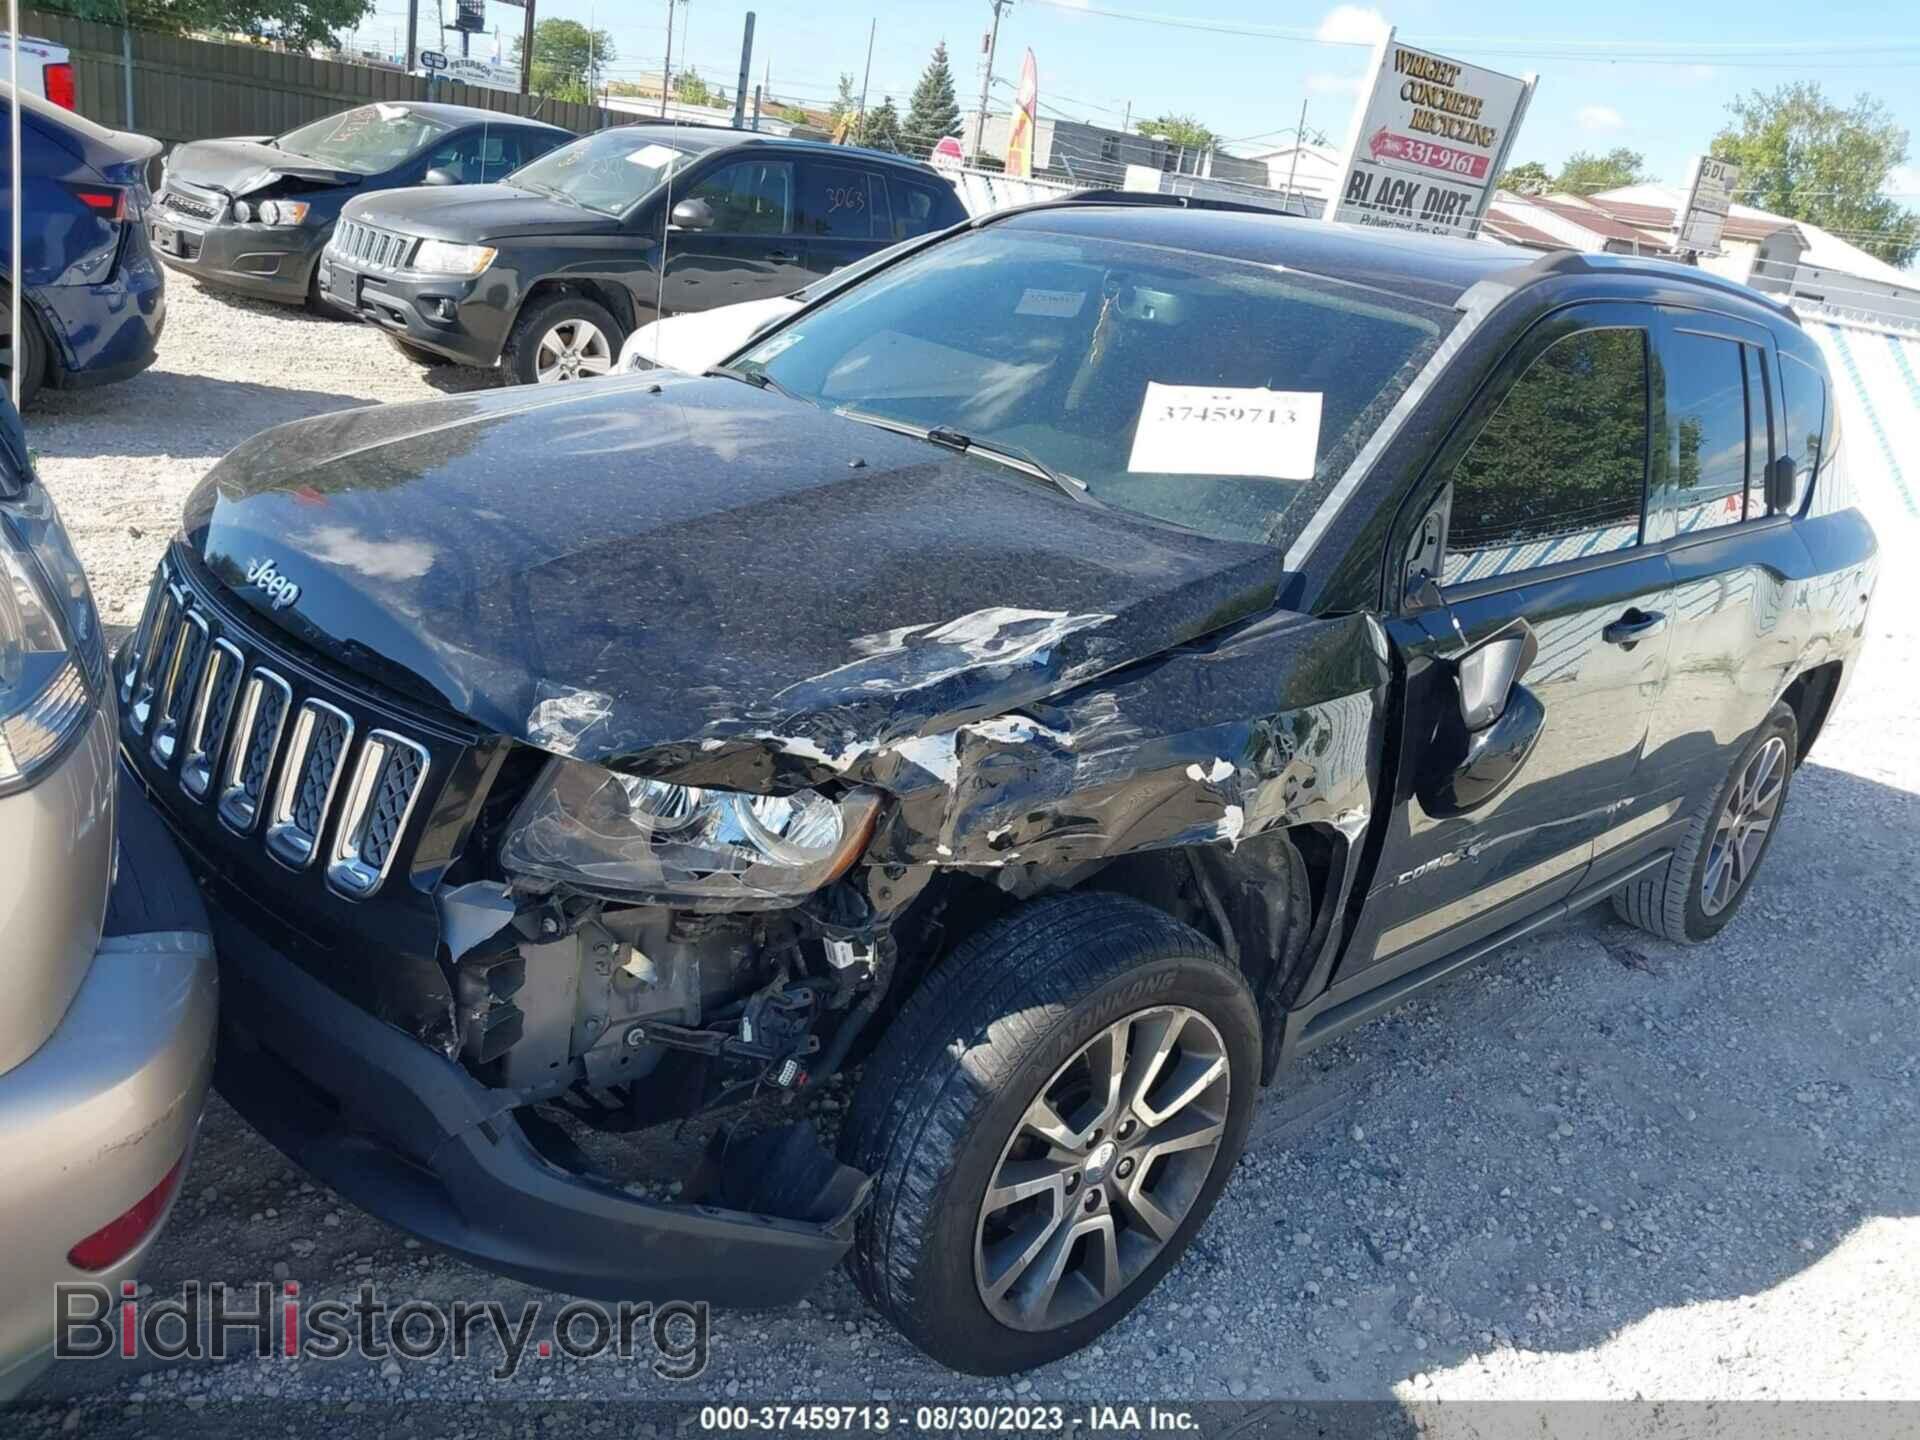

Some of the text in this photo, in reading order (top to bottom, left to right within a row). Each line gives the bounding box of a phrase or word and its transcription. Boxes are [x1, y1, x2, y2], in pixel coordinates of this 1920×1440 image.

[1394, 48, 1461, 88] WRIGHT
[1401, 79, 1483, 120] CONCRETE
[1408, 107, 1498, 149] RECYCLING
[1400, 139, 1477, 176] 331-9161
[1344, 170, 1472, 226] BLACK DIRT
[1159, 406, 1298, 425] 37459713
[246, 557, 299, 610] Jeep
